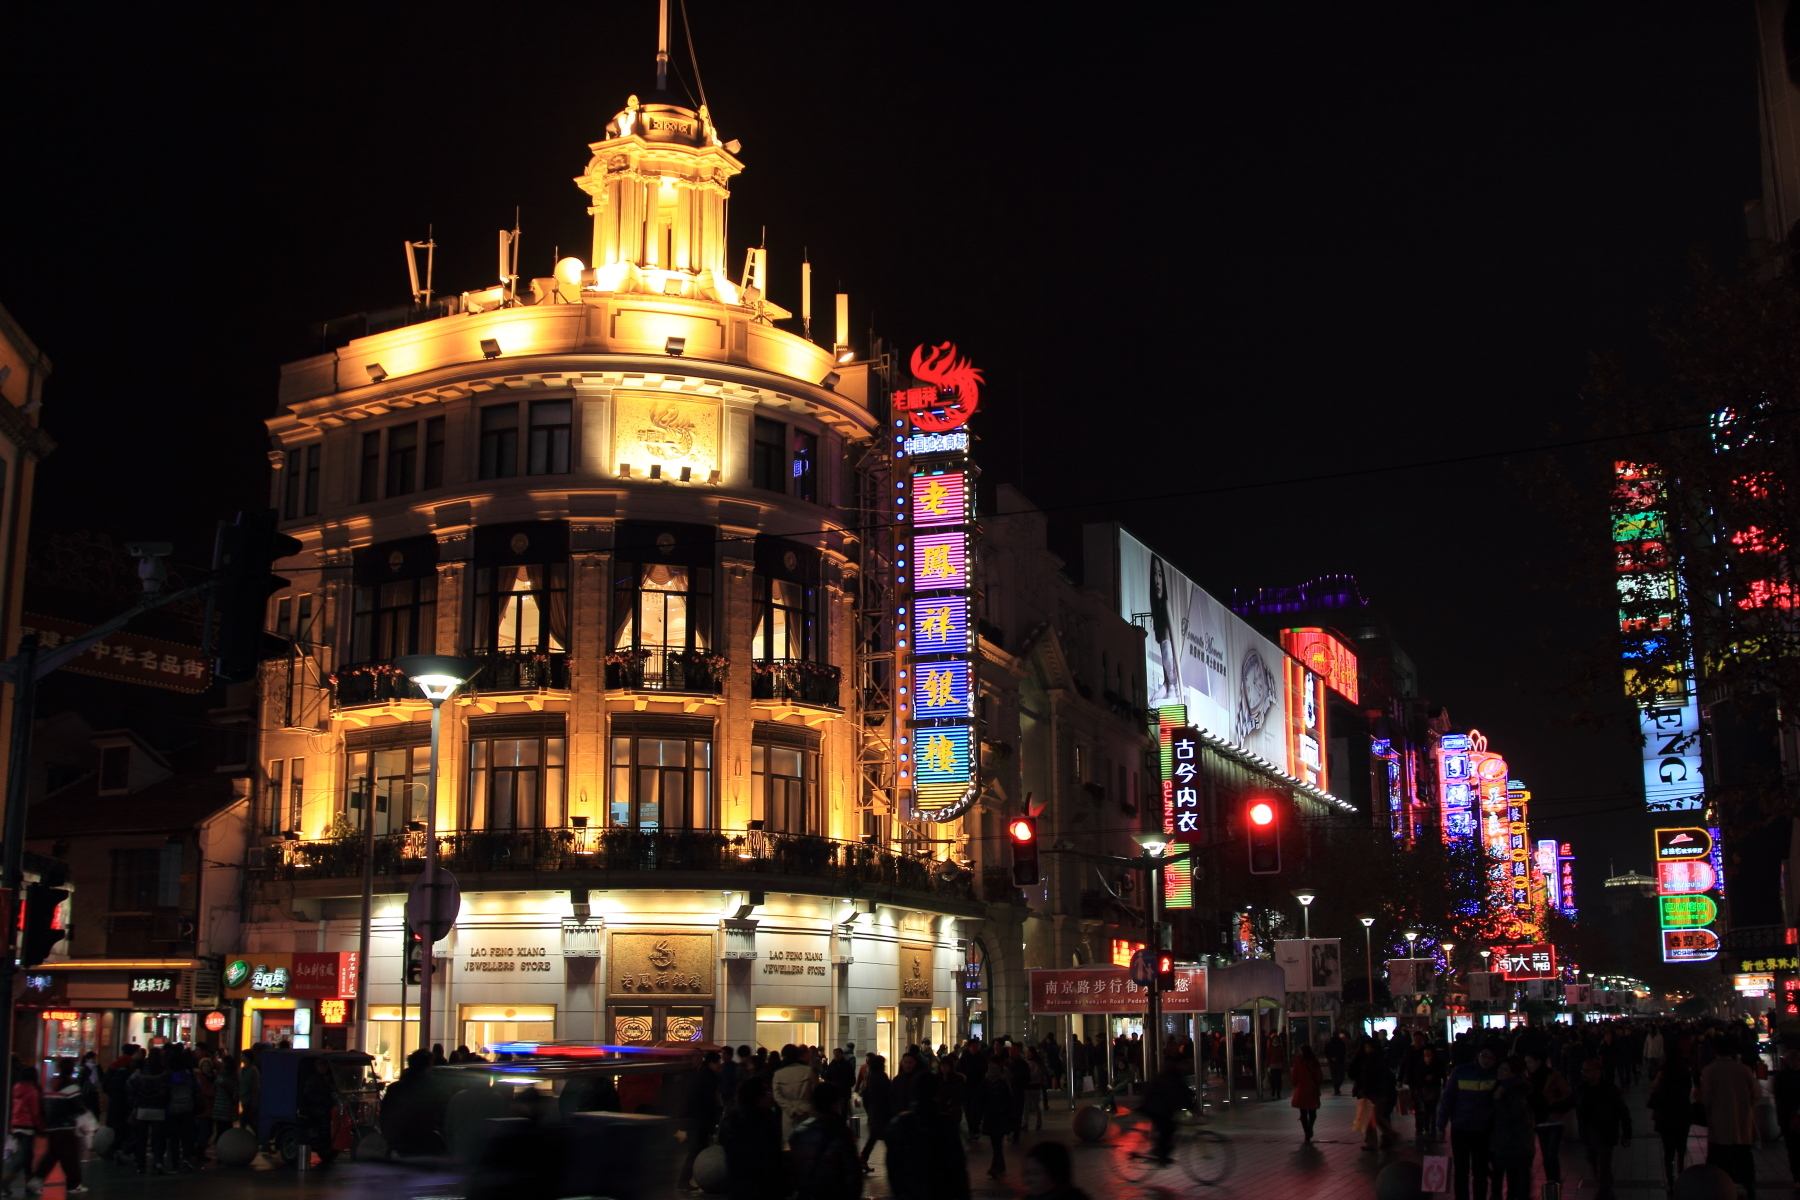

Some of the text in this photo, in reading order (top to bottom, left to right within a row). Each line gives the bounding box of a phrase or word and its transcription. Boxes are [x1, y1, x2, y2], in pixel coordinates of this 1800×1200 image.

[904, 434, 966, 454] 中国驰名商标
[1174, 738, 1199, 832] 古今内衣
[470, 947, 546, 957] LAO FENG XIANG
[769, 950, 783, 960] LAO
[464, 961, 551, 972] JEWELLERS STORE
[1045, 979, 1191, 994] 南京路步行街您
